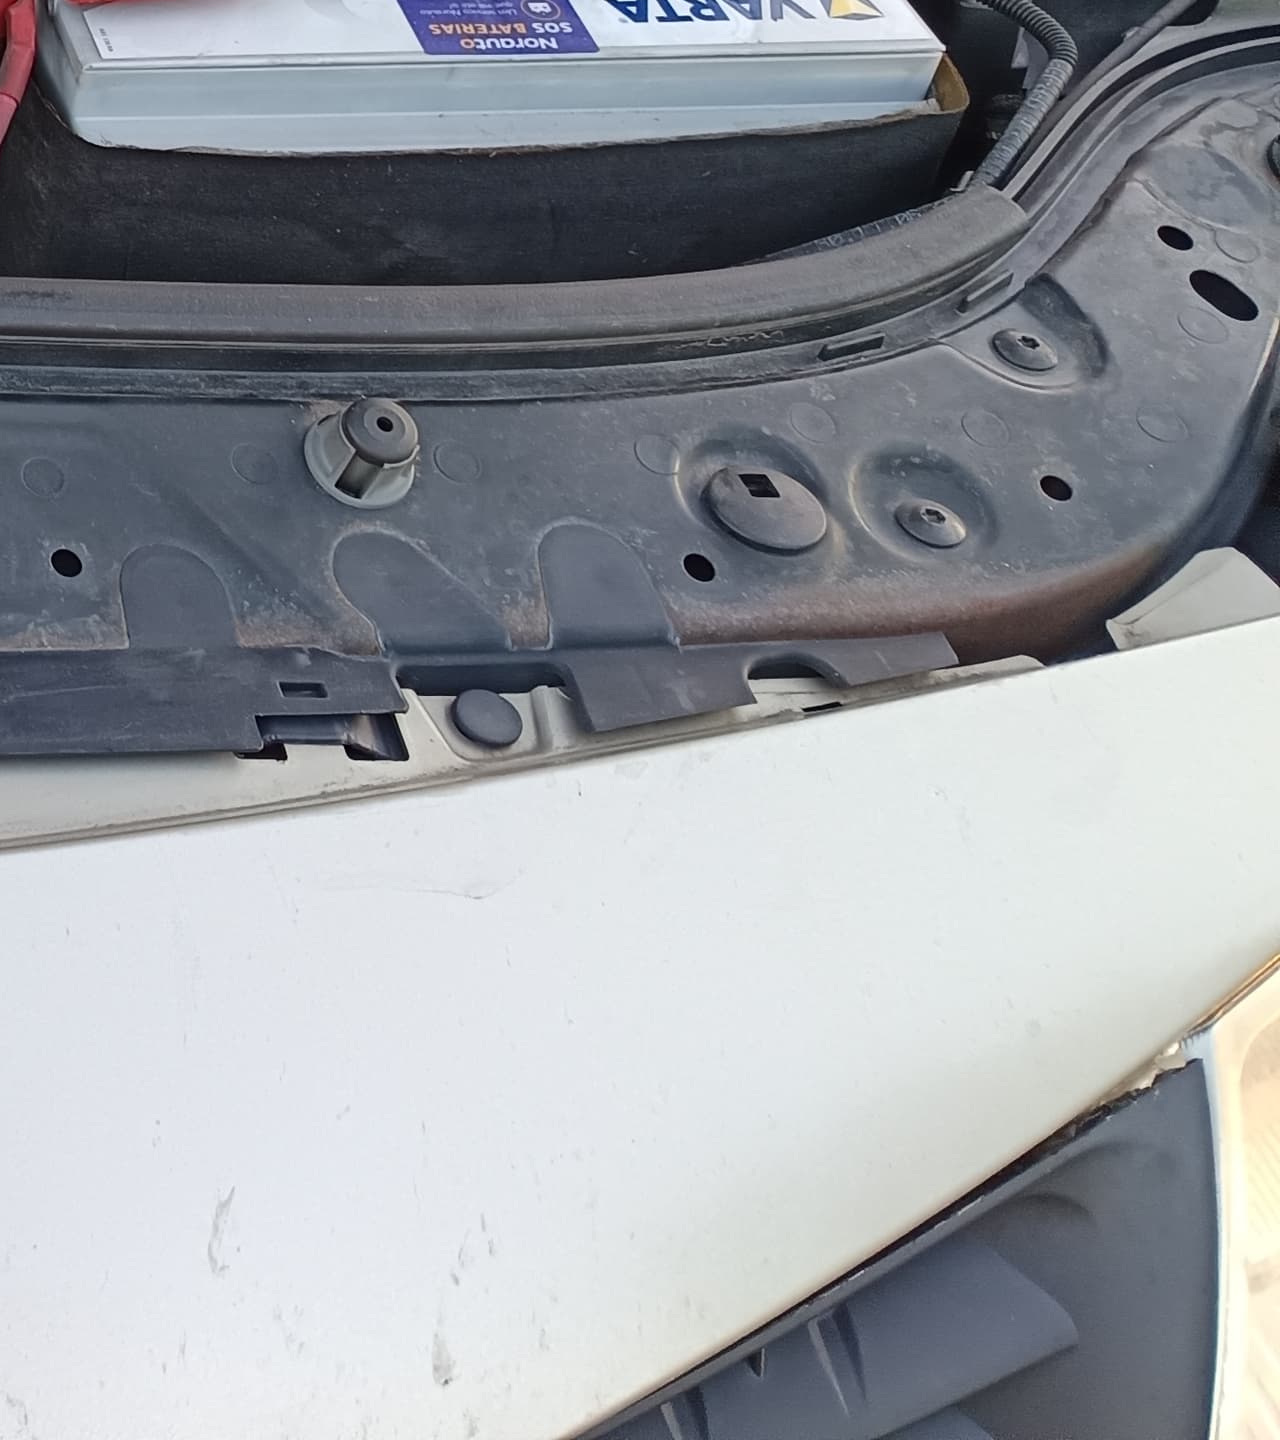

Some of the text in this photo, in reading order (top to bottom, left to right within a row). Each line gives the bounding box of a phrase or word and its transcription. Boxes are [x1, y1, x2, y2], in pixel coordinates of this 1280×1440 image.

[429, 22, 572, 34] SOS BATERIAS
[461, 37, 558, 49] Norauto
